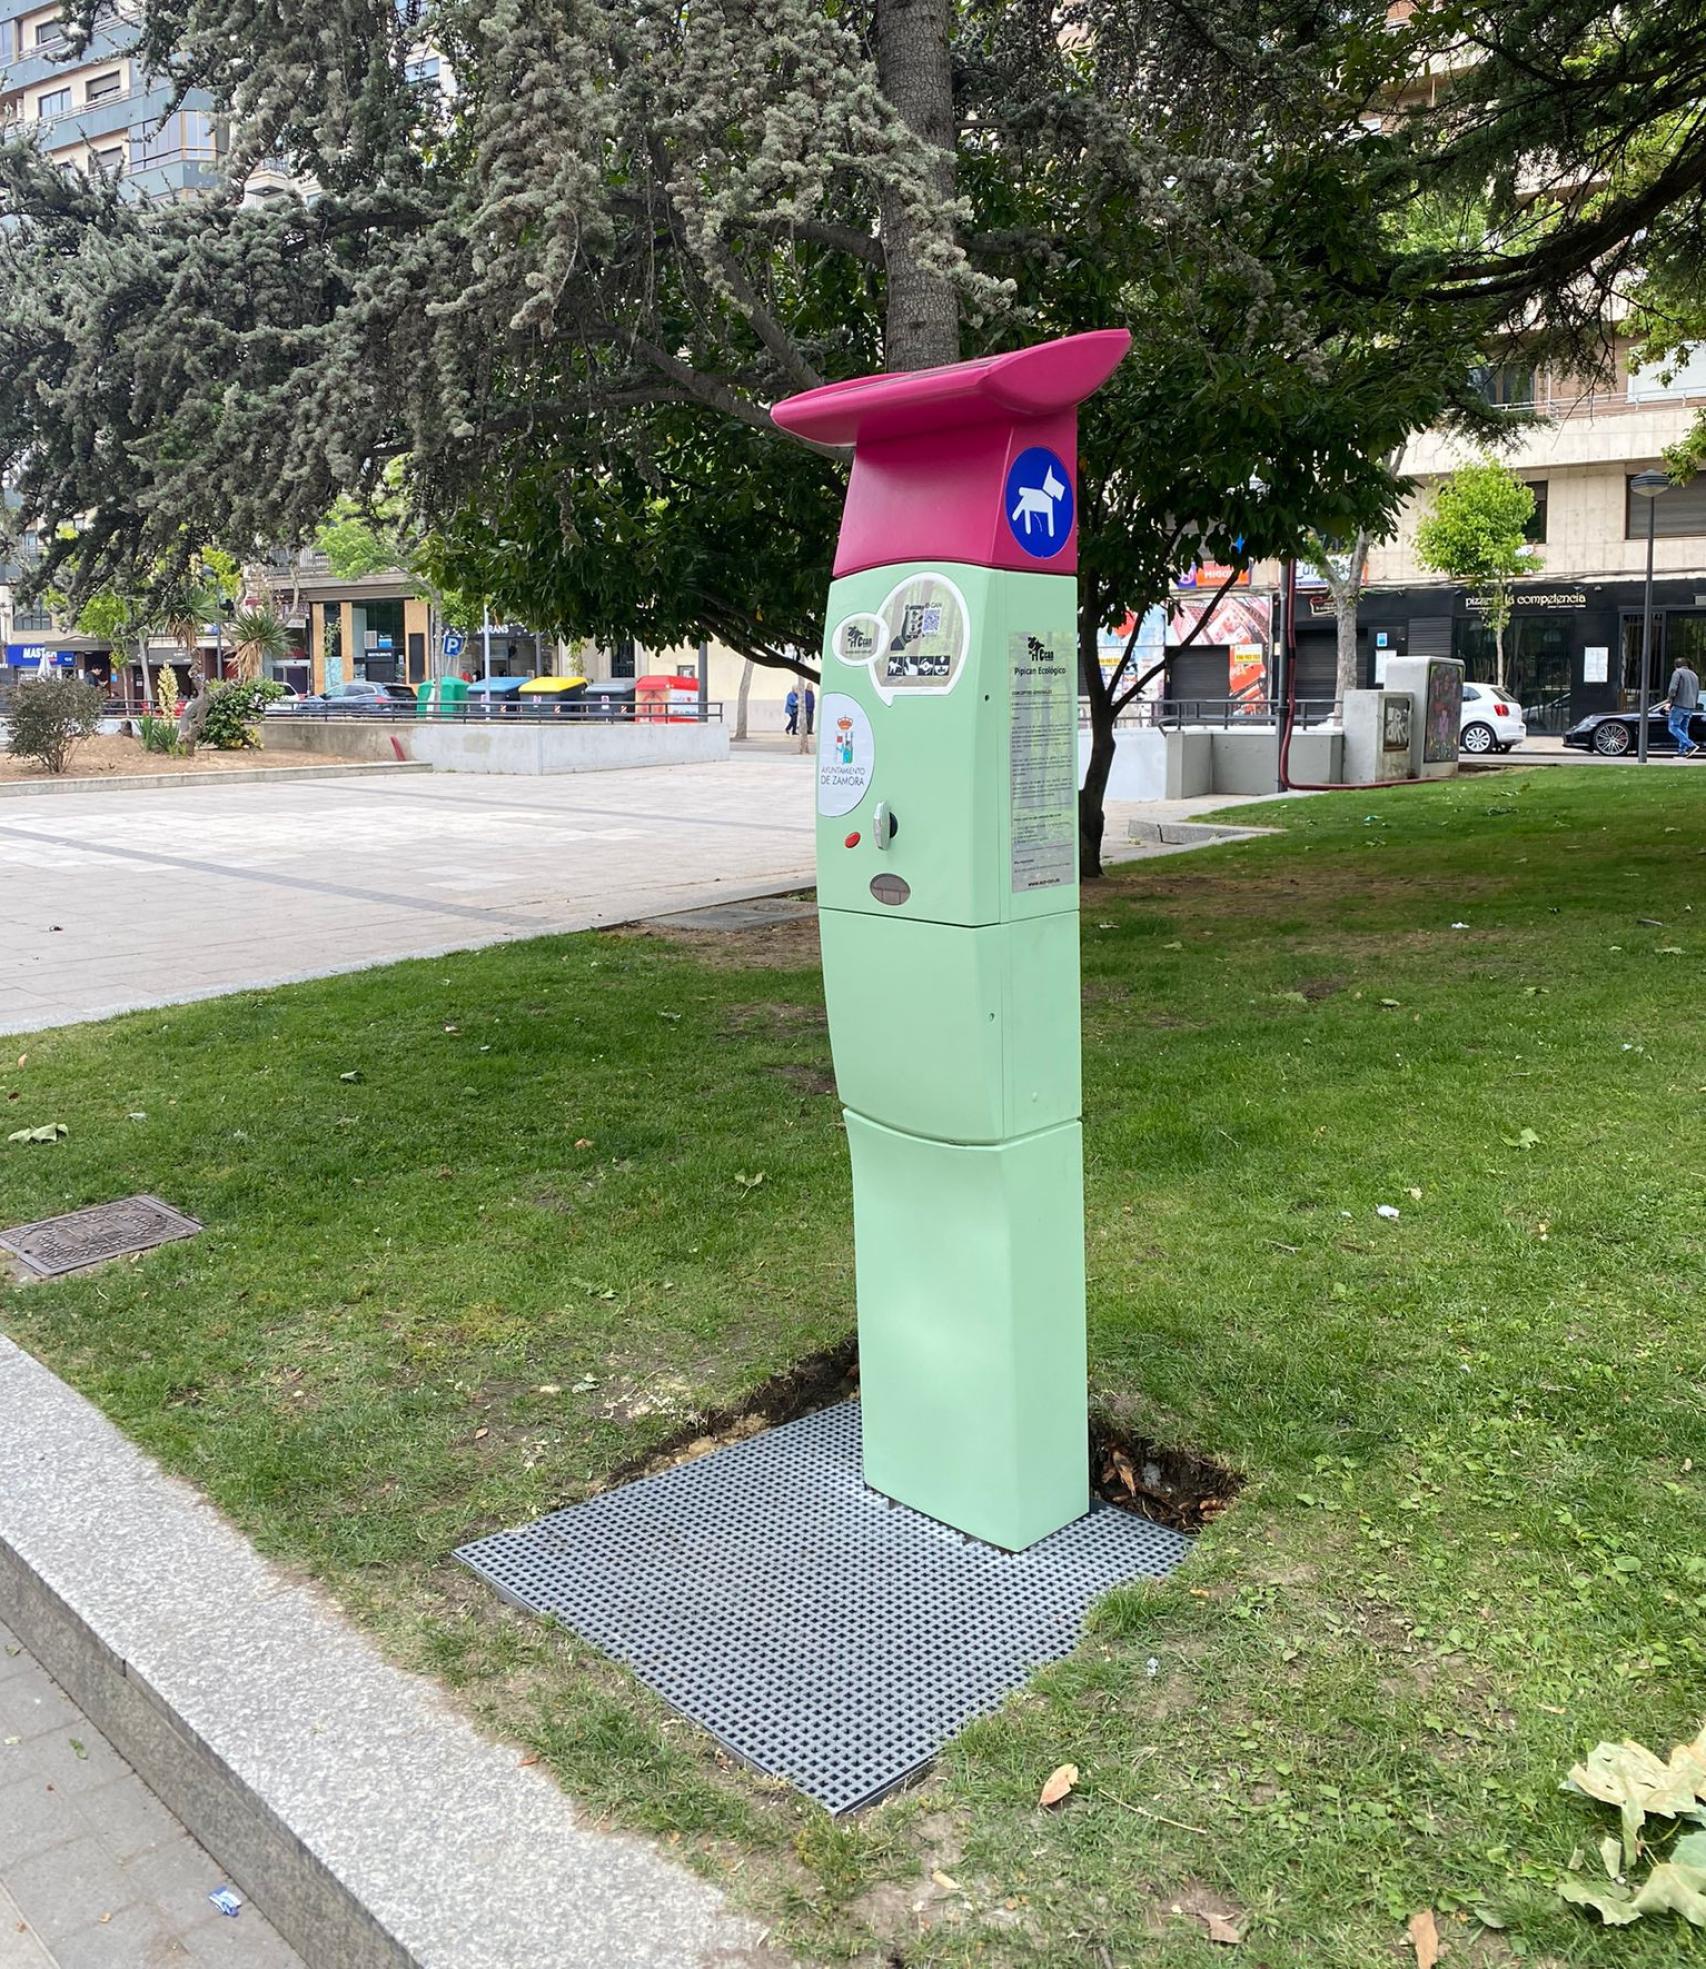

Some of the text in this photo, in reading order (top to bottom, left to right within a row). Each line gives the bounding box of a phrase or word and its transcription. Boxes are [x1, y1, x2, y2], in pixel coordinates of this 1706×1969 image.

[1516, 592, 1587, 607] competencia
[446, 637, 460, 653] P
[1014, 665, 1066, 676] Pipican Ecológico
[820, 765, 866, 776] AYUNTAMIENTO
[820, 775, 865, 787] DE ZAMORA
